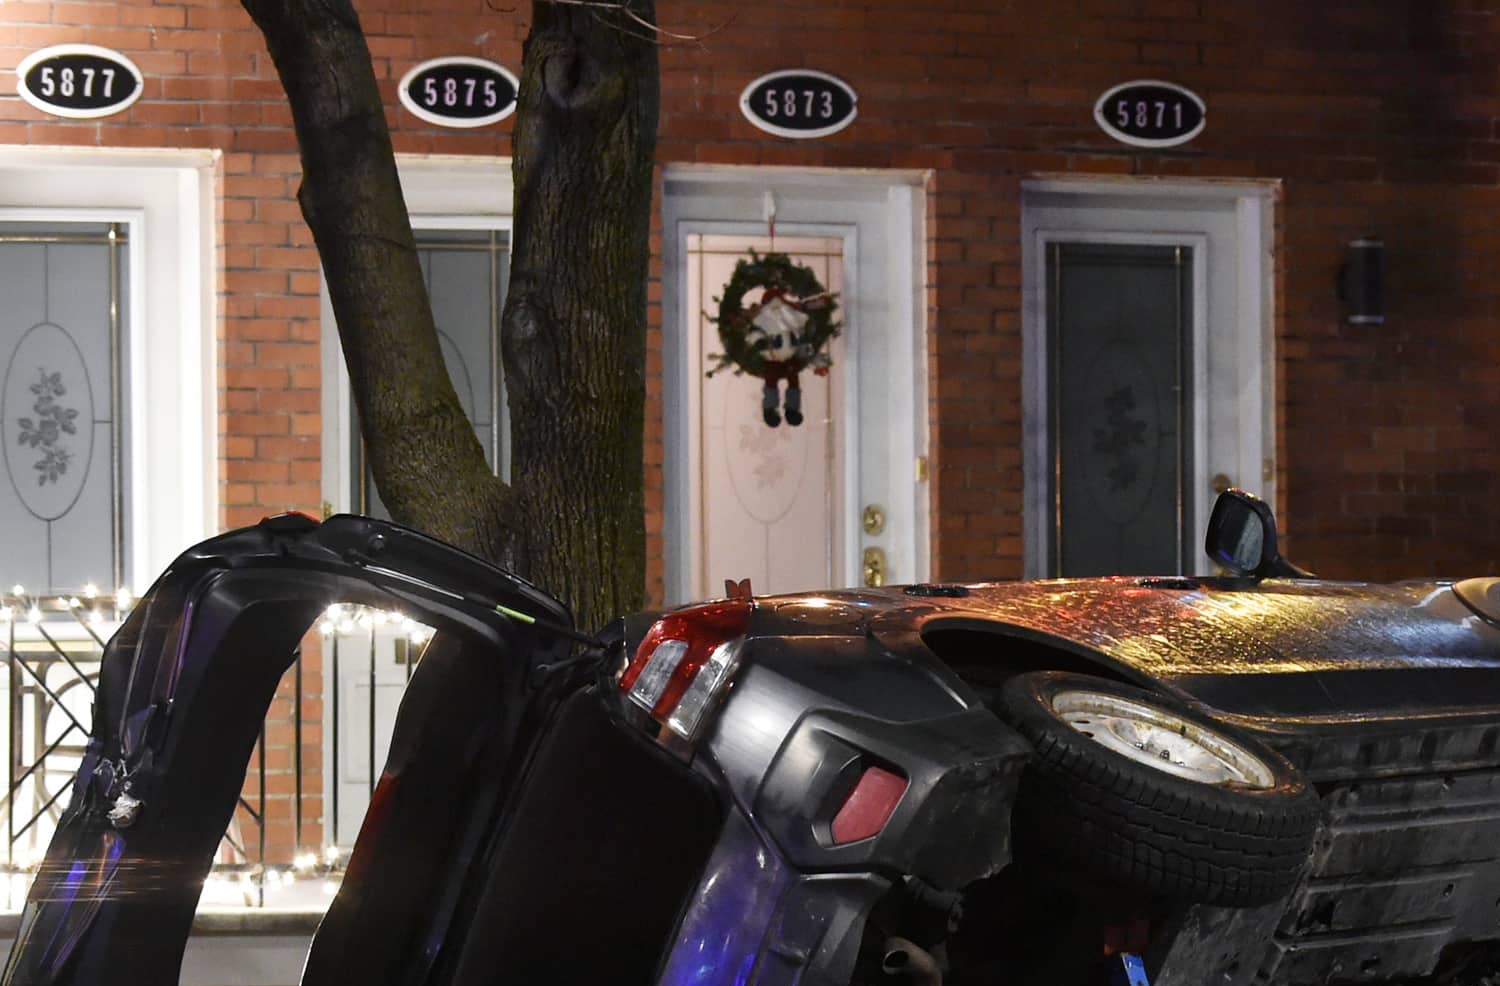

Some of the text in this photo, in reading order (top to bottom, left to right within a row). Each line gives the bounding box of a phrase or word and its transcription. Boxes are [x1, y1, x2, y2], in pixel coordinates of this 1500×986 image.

[41, 67, 116, 98] 5877
[424, 77, 498, 108] 5875
[765, 88, 834, 118] 5873
[1117, 100, 1183, 129] 5871
